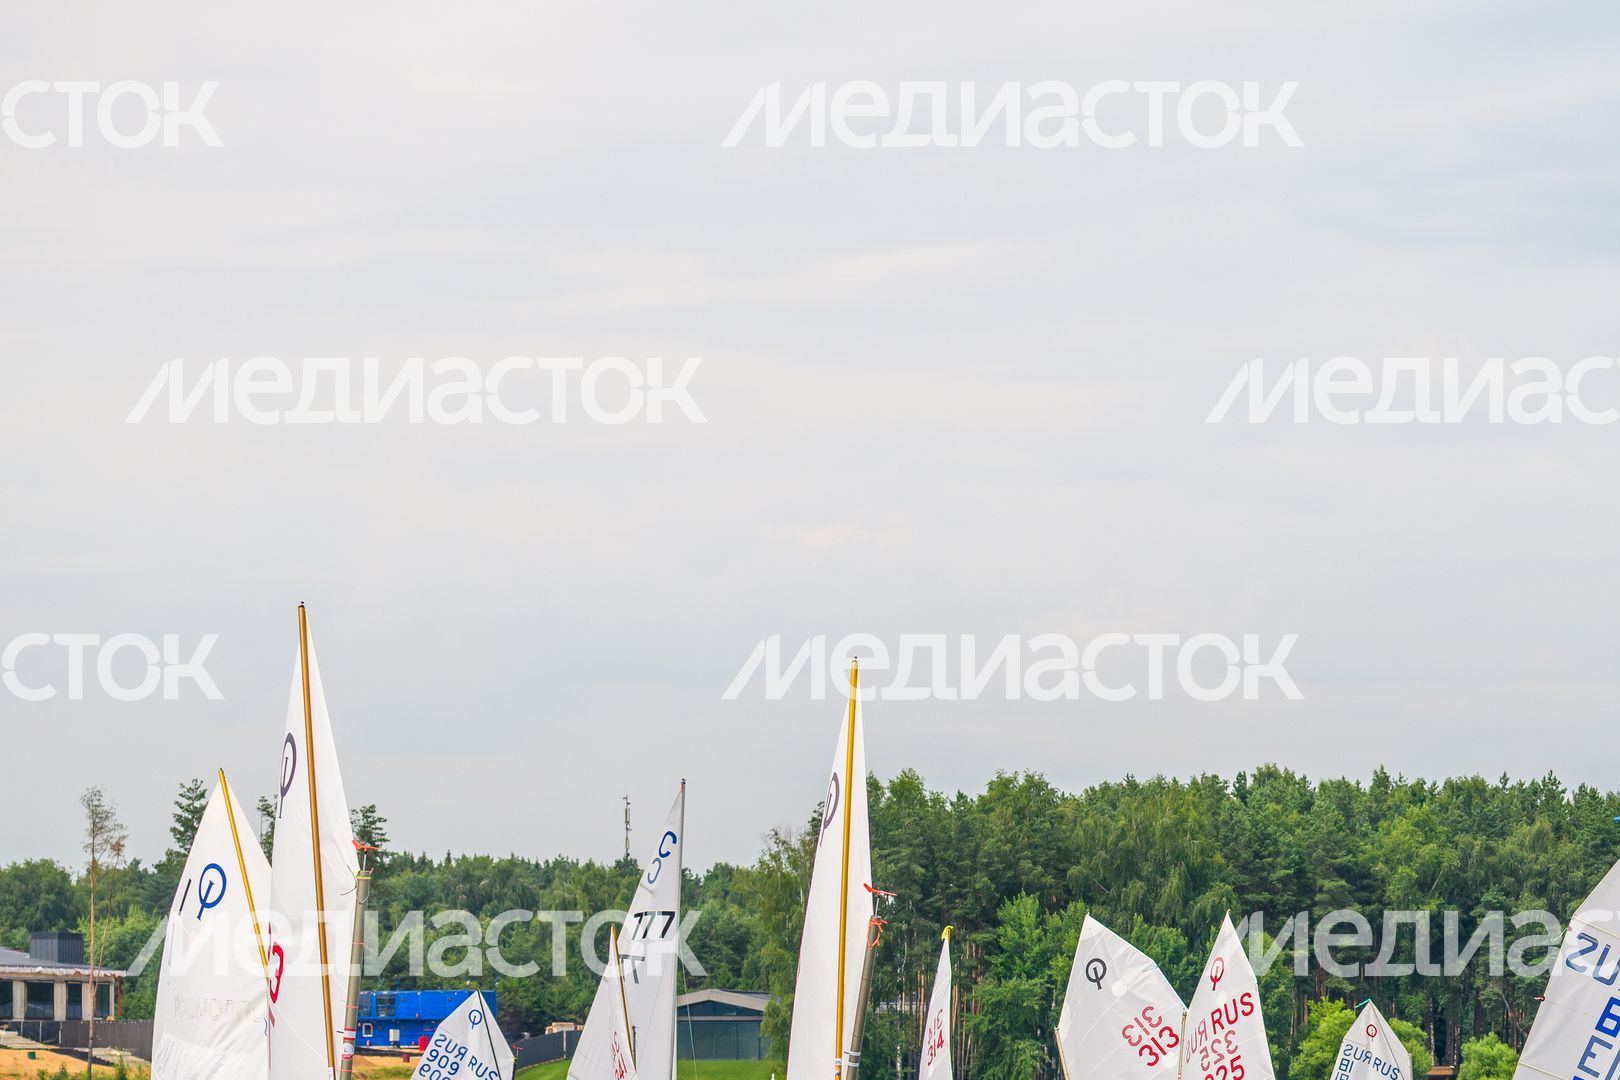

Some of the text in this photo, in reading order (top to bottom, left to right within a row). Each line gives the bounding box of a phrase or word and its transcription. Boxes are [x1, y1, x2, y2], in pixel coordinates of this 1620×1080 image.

[1210, 991, 1255, 1035] RUS
[427, 1049, 460, 1075] 909
[927, 1029, 944, 1067] 314
[1139, 1026, 1179, 1067] 313
[1339, 1058, 1354, 1073] 81
[1372, 1057, 1400, 1080] RUS
